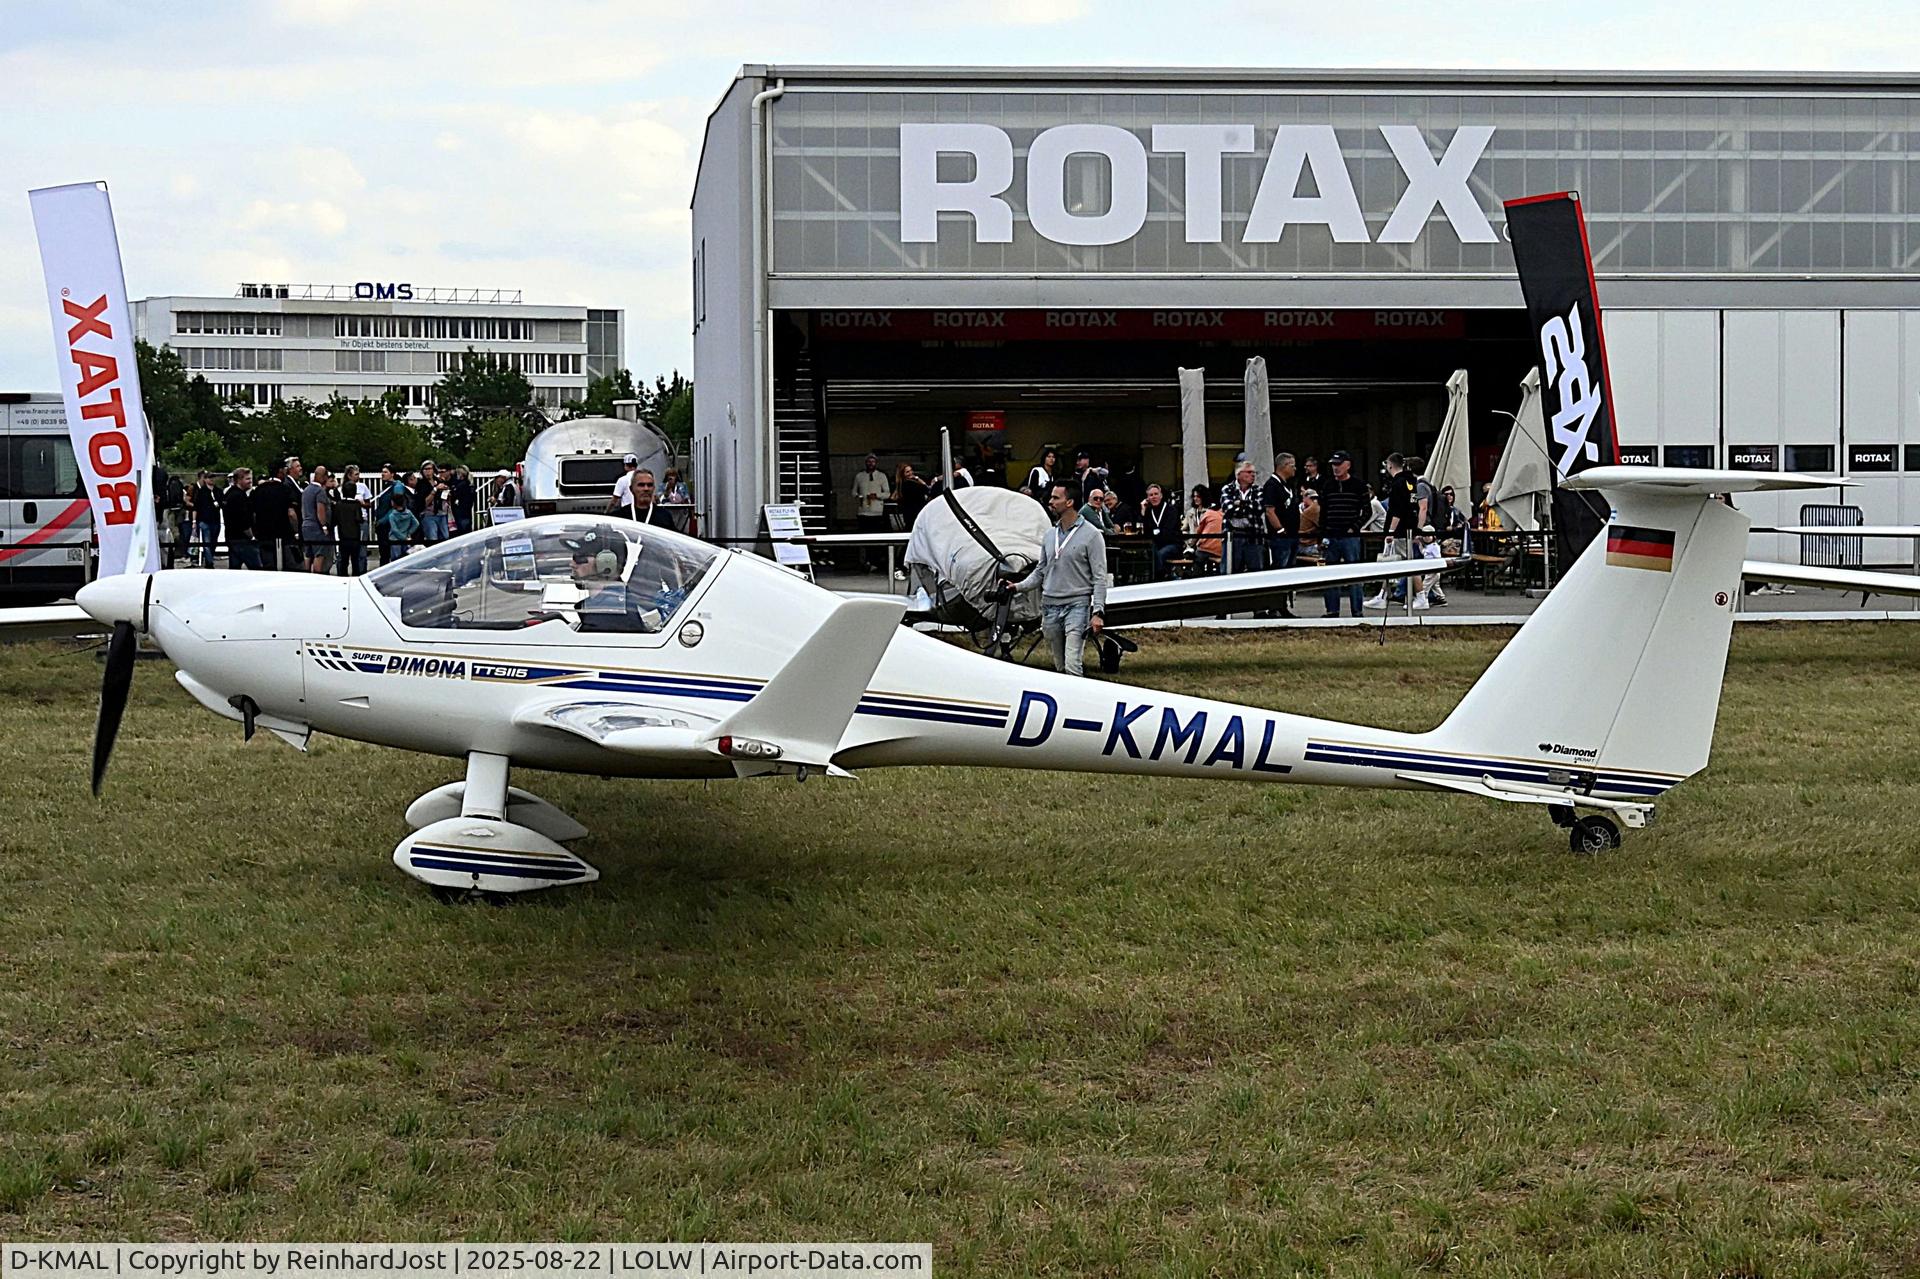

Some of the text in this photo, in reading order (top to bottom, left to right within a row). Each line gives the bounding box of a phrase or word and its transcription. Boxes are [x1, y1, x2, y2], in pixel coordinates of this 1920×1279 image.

[900, 123, 1500, 246] ROTAX
[355, 282, 413, 300] OMS
[820, 312, 892, 327] ROTAX
[933, 312, 1005, 327] ROTAX
[1046, 312, 1118, 327] ROTAX
[1153, 312, 1224, 327] ROTAX
[1264, 312, 1335, 327] ROTAX
[1375, 312, 1444, 326] ROTAX
[340, 340, 350, 348] Ihr
[351, 340, 374, 349] Objekt
[375, 341, 403, 350] bestens
[1619, 455, 1650, 464] OTAX
[1734, 454, 1771, 463] ROTAX
[1855, 453, 1892, 462] ROTAX
[352, 652, 383, 661] SUPER
[386, 655, 466, 679] DIMONA
[1006, 690, 1293, 774] D-KMAL
[1552, 744, 1598, 758] Diamond
